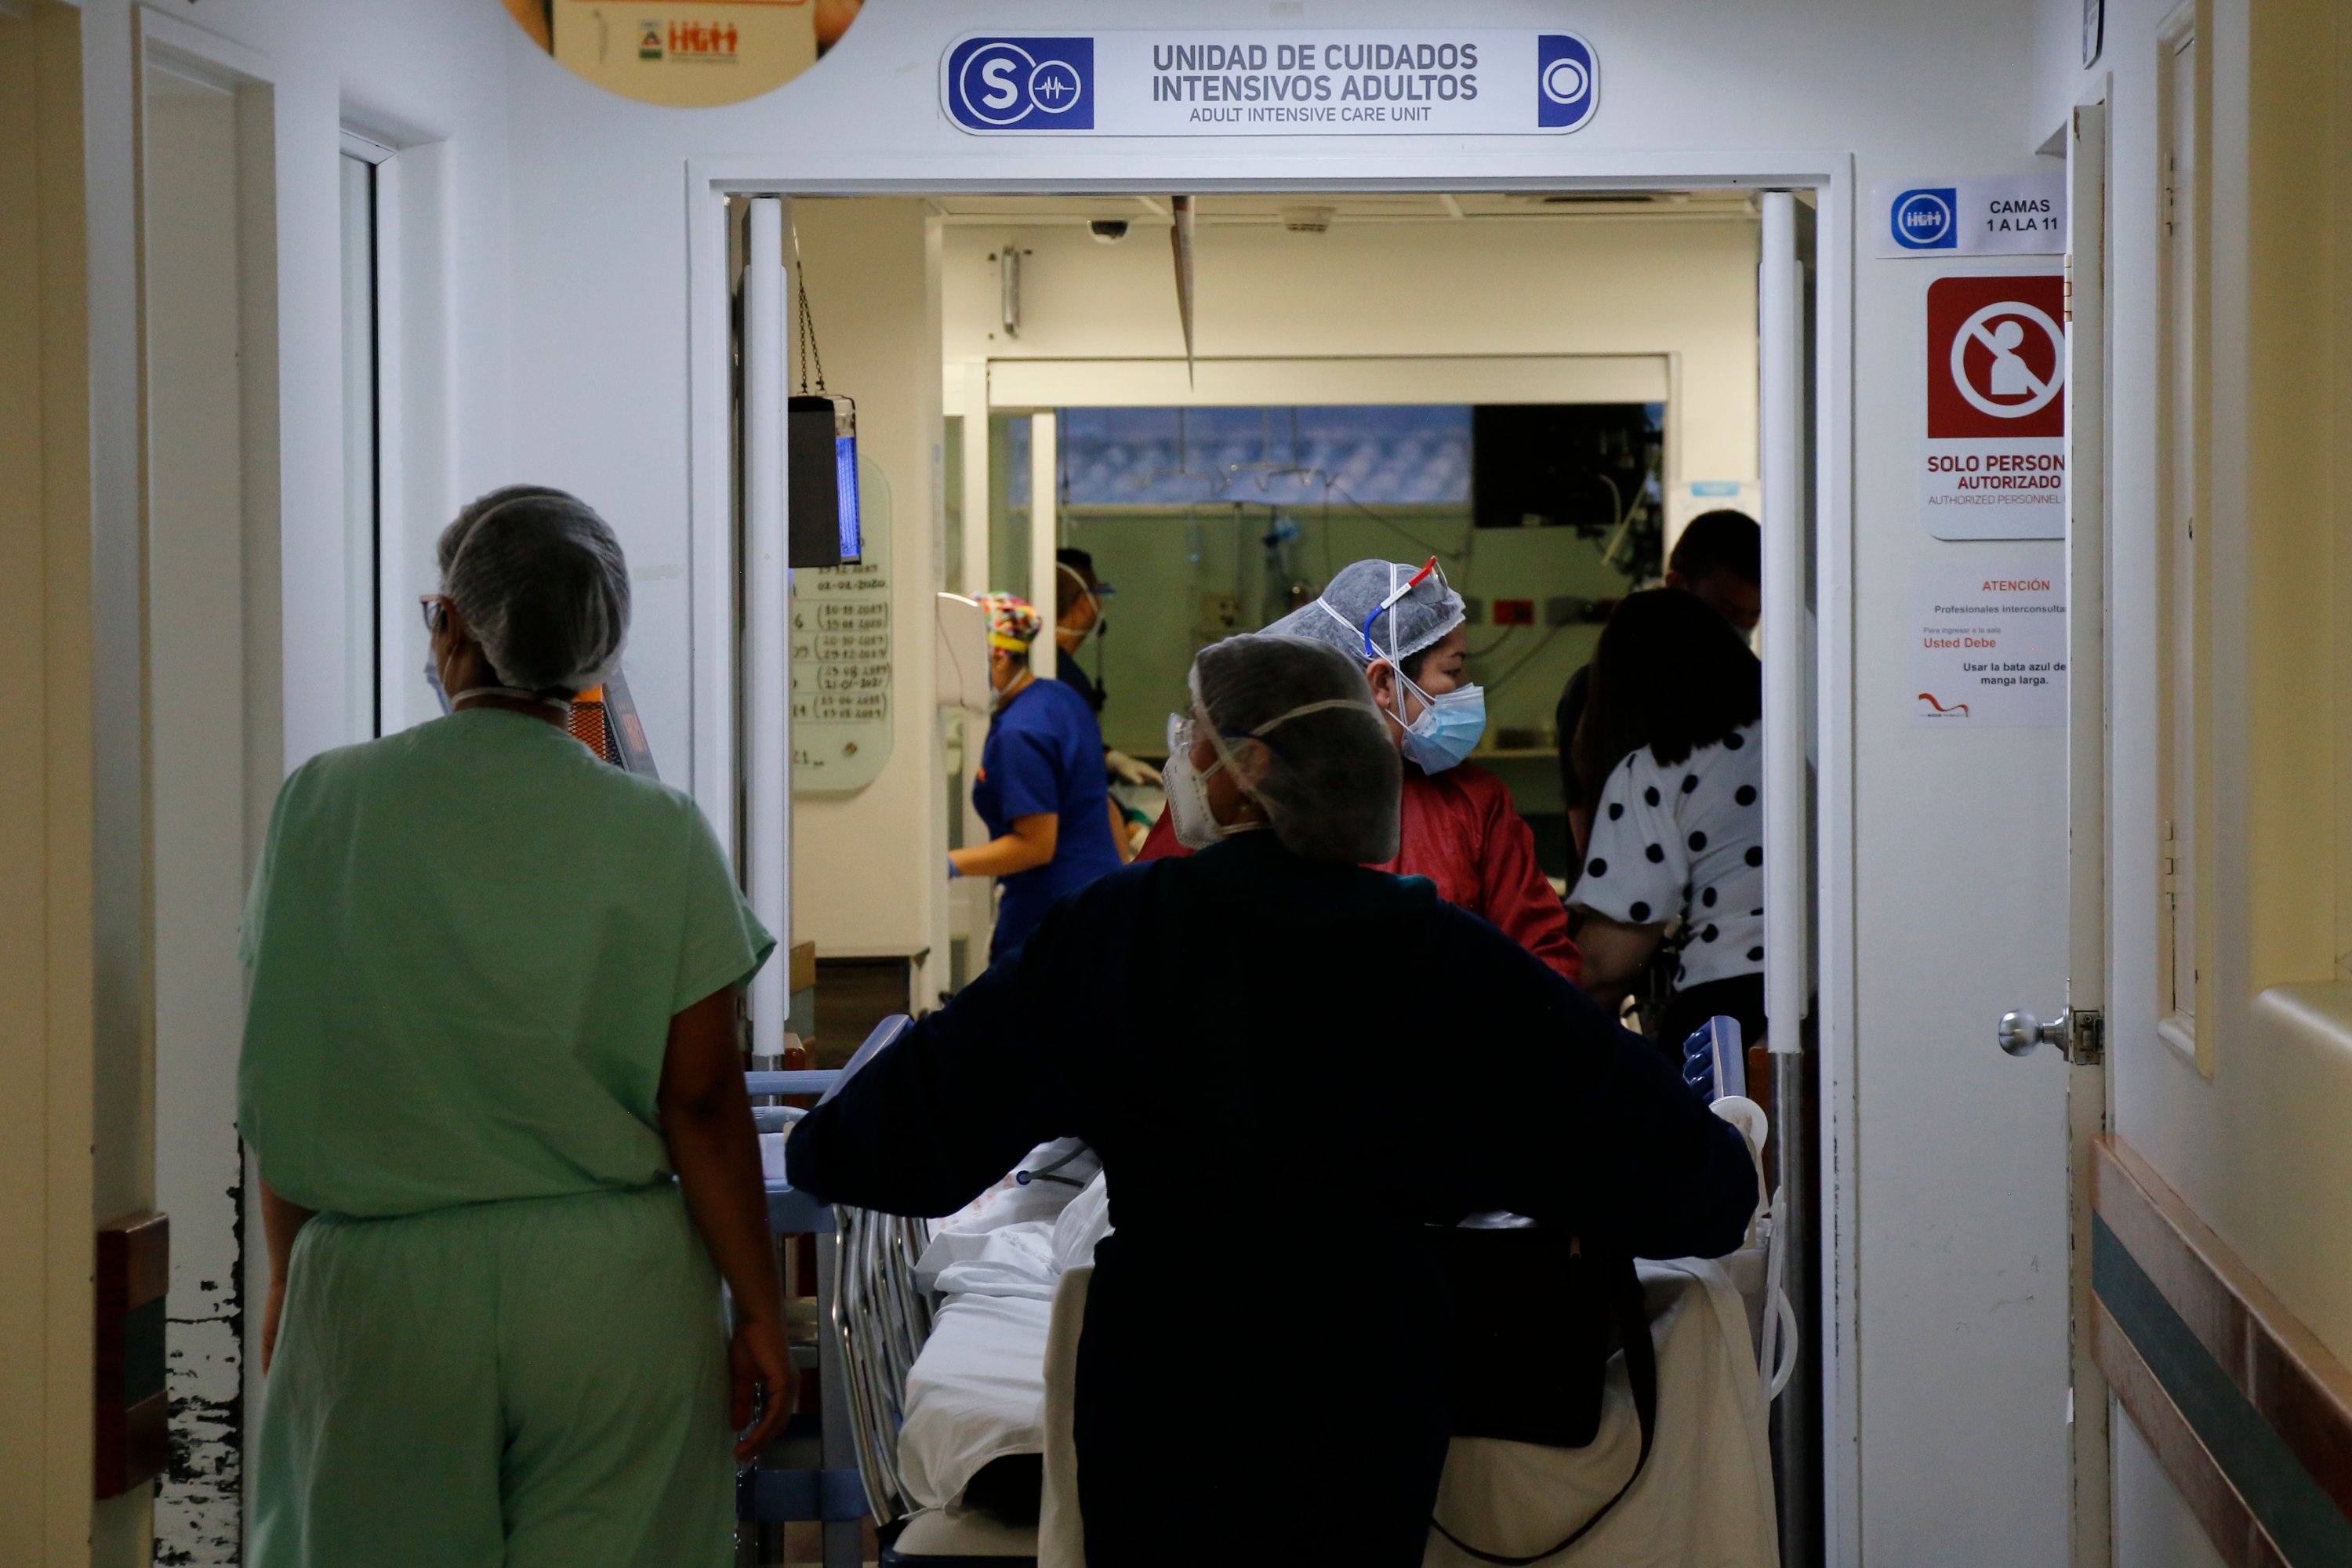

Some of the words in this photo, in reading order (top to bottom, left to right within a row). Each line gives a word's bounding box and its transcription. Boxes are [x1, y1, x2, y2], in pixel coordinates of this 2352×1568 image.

[1154, 45, 1266, 71] UNIDAD
[1278, 45, 1315, 70] DE
[1325, 44, 1477, 70] CUIDADOS
[1154, 75, 1331, 101] INTENSIVOS
[1341, 74, 1477, 100] ADULTOS
[1190, 108, 1243, 122] ADULT
[1249, 107, 1336, 122] INTENSIVE
[1342, 107, 1385, 121] CARE
[1392, 107, 1432, 121] UNIT
[1991, 200, 2050, 213] CAMAS
[1987, 220, 1993, 231] 1
[1999, 219, 2011, 231] A
[2016, 218, 2037, 230] LA
[2043, 217, 2056, 230] 11
[1928, 456, 1979, 472] SOLO
[1958, 475, 2061, 489] AUTORIZADO
[1929, 495, 1995, 505] AUTHORIZED
[1998, 495, 2061, 504] PERSONNEL
[1983, 579, 2049, 590] ATENCIÓN
[1925, 638, 1960, 648] Usted
[1965, 637, 1995, 648] Debe
[2054, 662, 2066, 671] de
[2020, 676, 2048, 686] larga.
